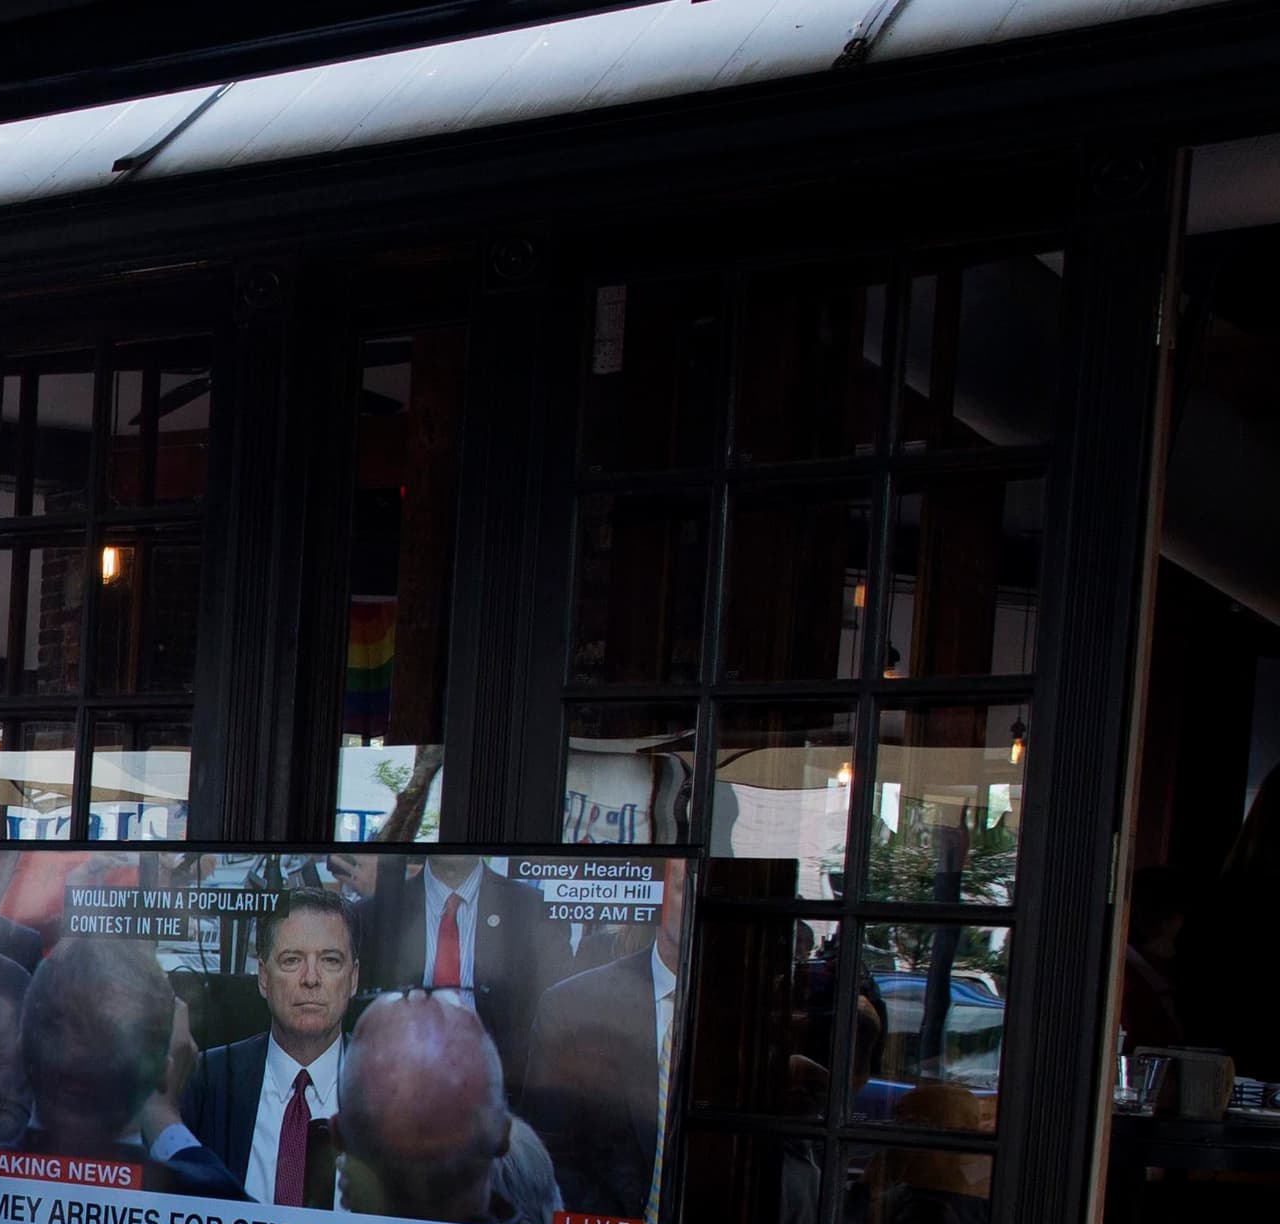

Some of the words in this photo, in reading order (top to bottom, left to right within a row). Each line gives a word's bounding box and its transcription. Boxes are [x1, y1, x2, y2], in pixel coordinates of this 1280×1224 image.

[519, 861, 578, 880] Comey
[584, 862, 653, 880] Hearing
[72, 889, 140, 908] WOULDN'T
[143, 891, 171, 910] WIN
[174, 892, 184, 910] A
[188, 892, 279, 912] POPULARITY
[556, 883, 618, 901] Capitol
[624, 884, 652, 899] Hill
[549, 905, 594, 921] 10:03
[599, 907, 628, 921] AM
[634, 907, 656, 921] ET
[70, 914, 132, 934] CONTEST
[137, 916, 151, 935] IN
[155, 917, 181, 936] THE
[68, 1163, 132, 1186] NEWS
